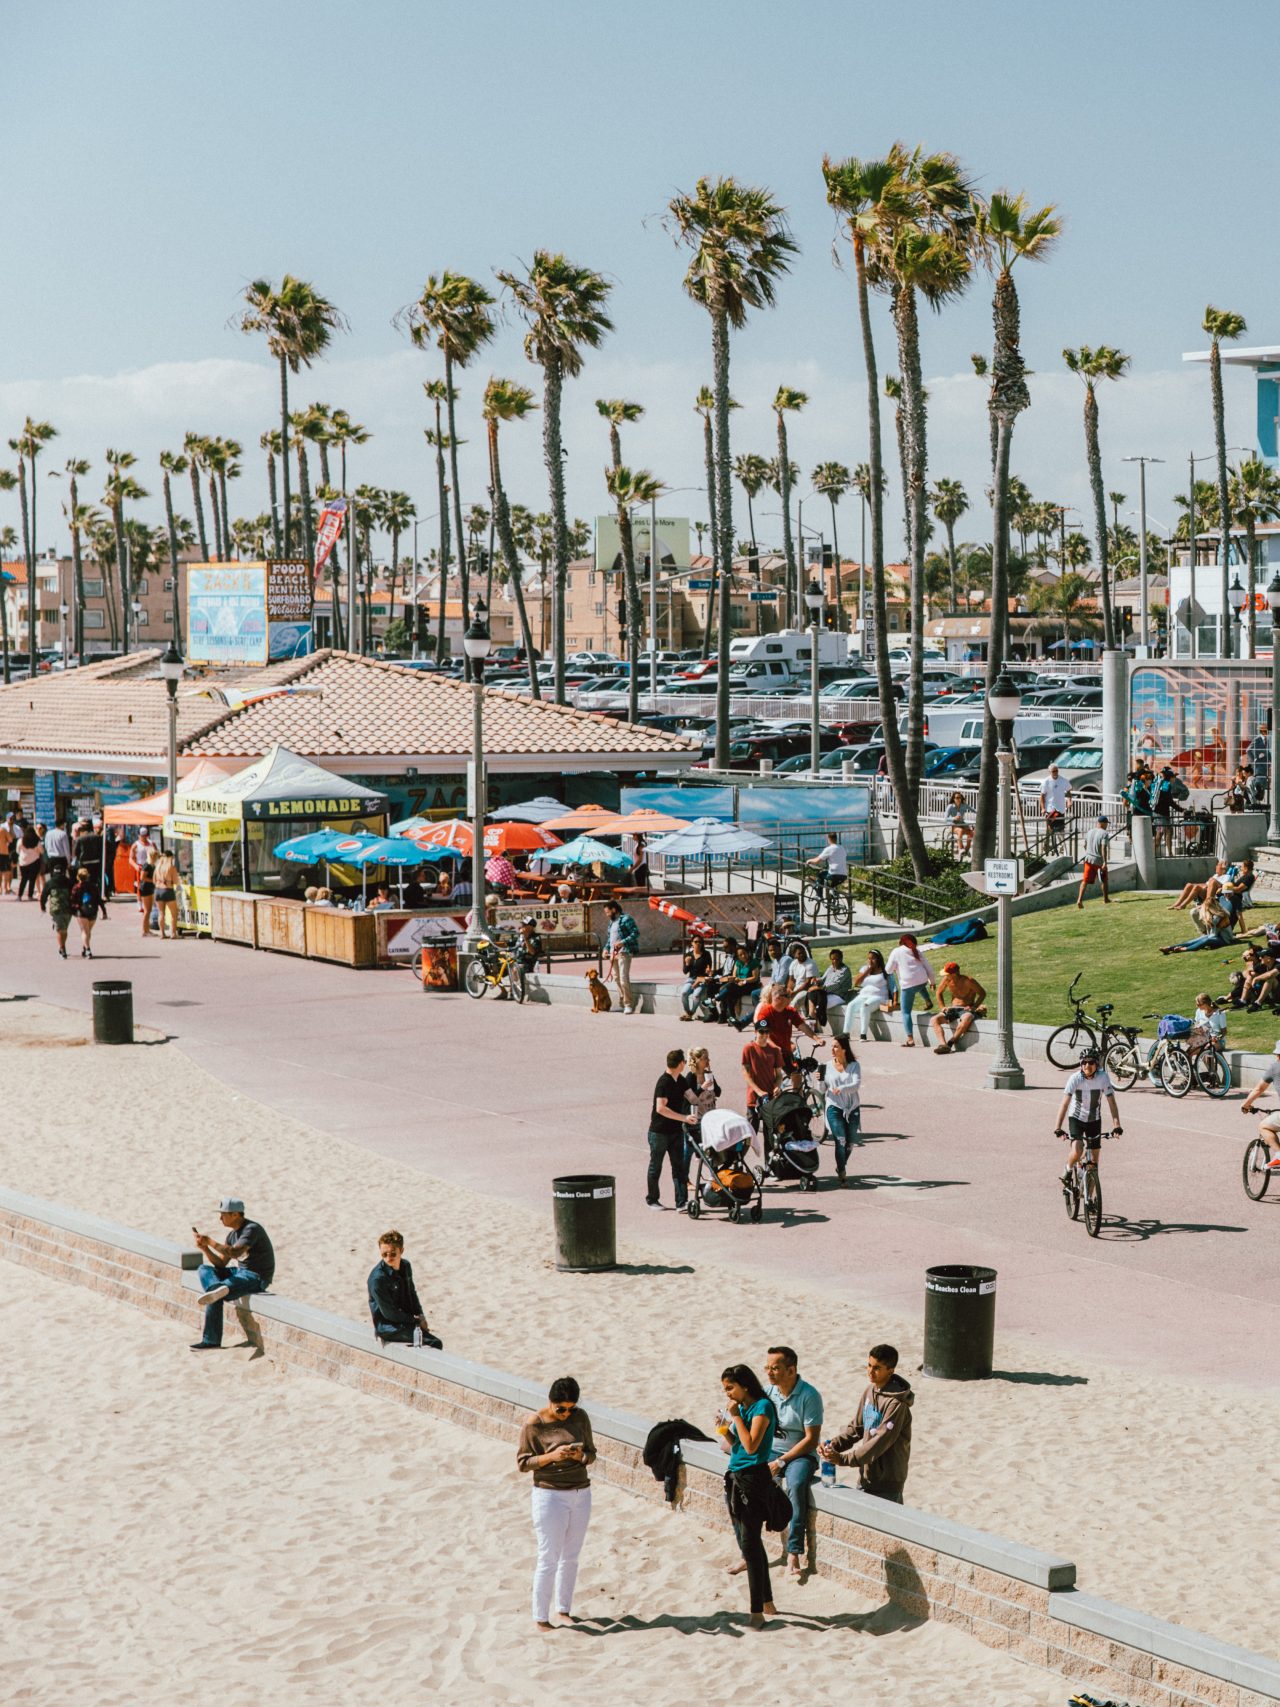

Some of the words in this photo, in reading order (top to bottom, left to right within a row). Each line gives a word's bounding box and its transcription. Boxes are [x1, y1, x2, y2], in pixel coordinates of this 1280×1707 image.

[272, 563, 306, 575] FOOD
[268, 575, 309, 584] BEACH
[268, 585, 311, 594] RENTALS
[267, 594, 312, 605] SURFBOARD
[268, 604, 311, 616] Wetsuits
[186, 799, 228, 815] LEMONADE
[268, 798, 361, 816] LEMONADE
[935, 1283, 958, 1293] Beaches
[959, 1286, 977, 1294] Clean
